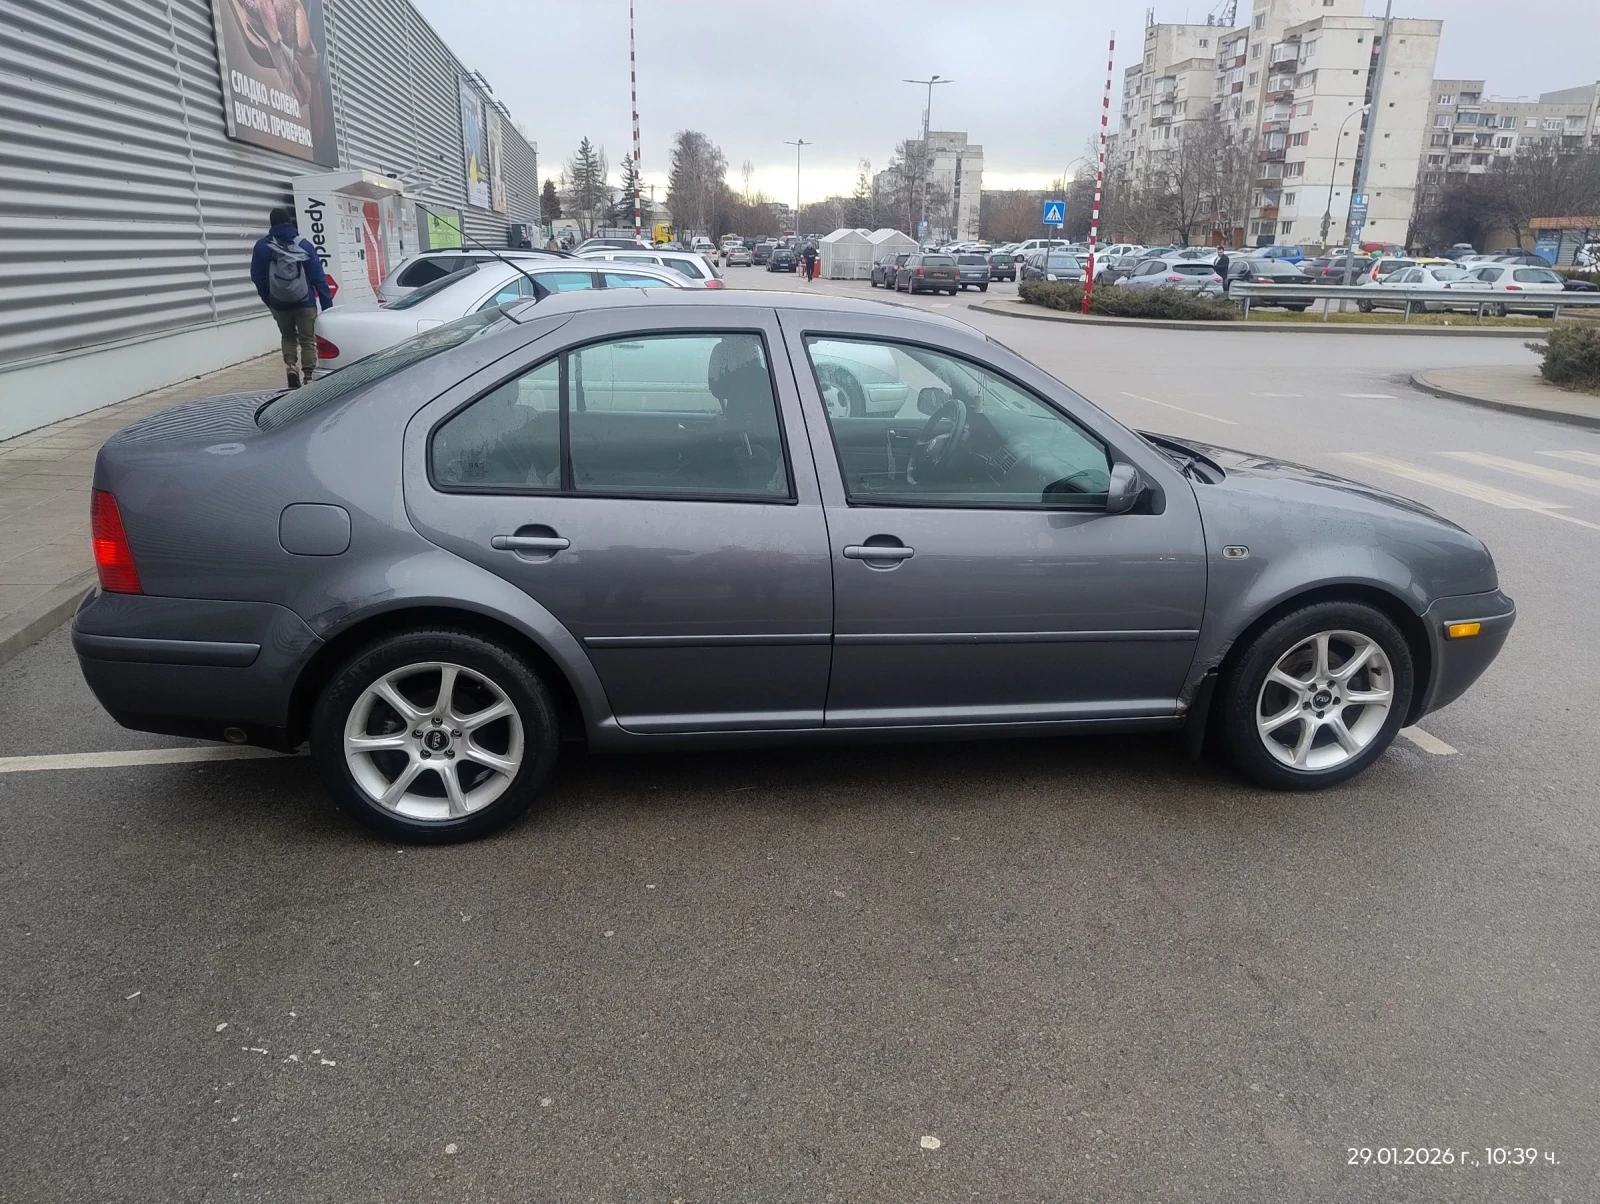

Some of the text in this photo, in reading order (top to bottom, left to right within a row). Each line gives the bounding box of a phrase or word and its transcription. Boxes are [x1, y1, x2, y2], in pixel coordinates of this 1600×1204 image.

[231, 69, 302, 119] СЛАДКО. СОЛЕНО.
[234, 100, 314, 148] ВКУСНО. ПРОВЕРЕНО.
